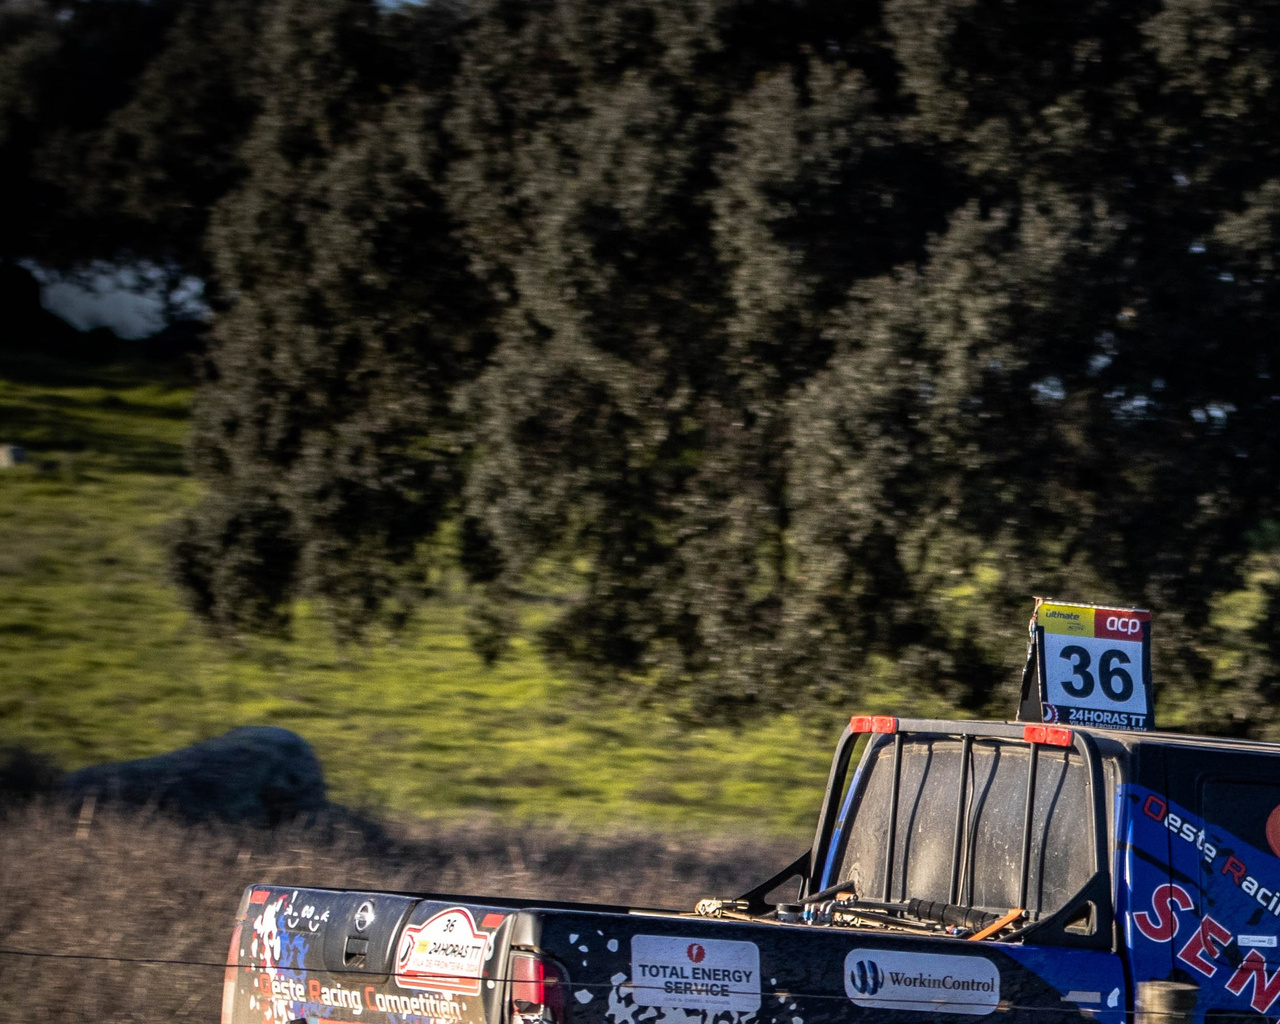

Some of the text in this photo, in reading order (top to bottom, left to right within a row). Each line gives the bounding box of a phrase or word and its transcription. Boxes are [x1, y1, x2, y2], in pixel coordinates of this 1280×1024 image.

[1046, 610, 1080, 620] ultimate
[1106, 616, 1140, 635] acp
[1059, 645, 1133, 702] 36
[1130, 714, 1146, 727] TT
[1144, 793, 1218, 863] Oeste
[443, 919, 457, 932] 36
[470, 945, 482, 959] TT
[638, 964, 753, 983] TOTAL ENERGY
[889, 971, 995, 992] WorkinControl
[259, 973, 462, 1022] Oeste Racing Competition
[664, 981, 730, 997] SERVICE
